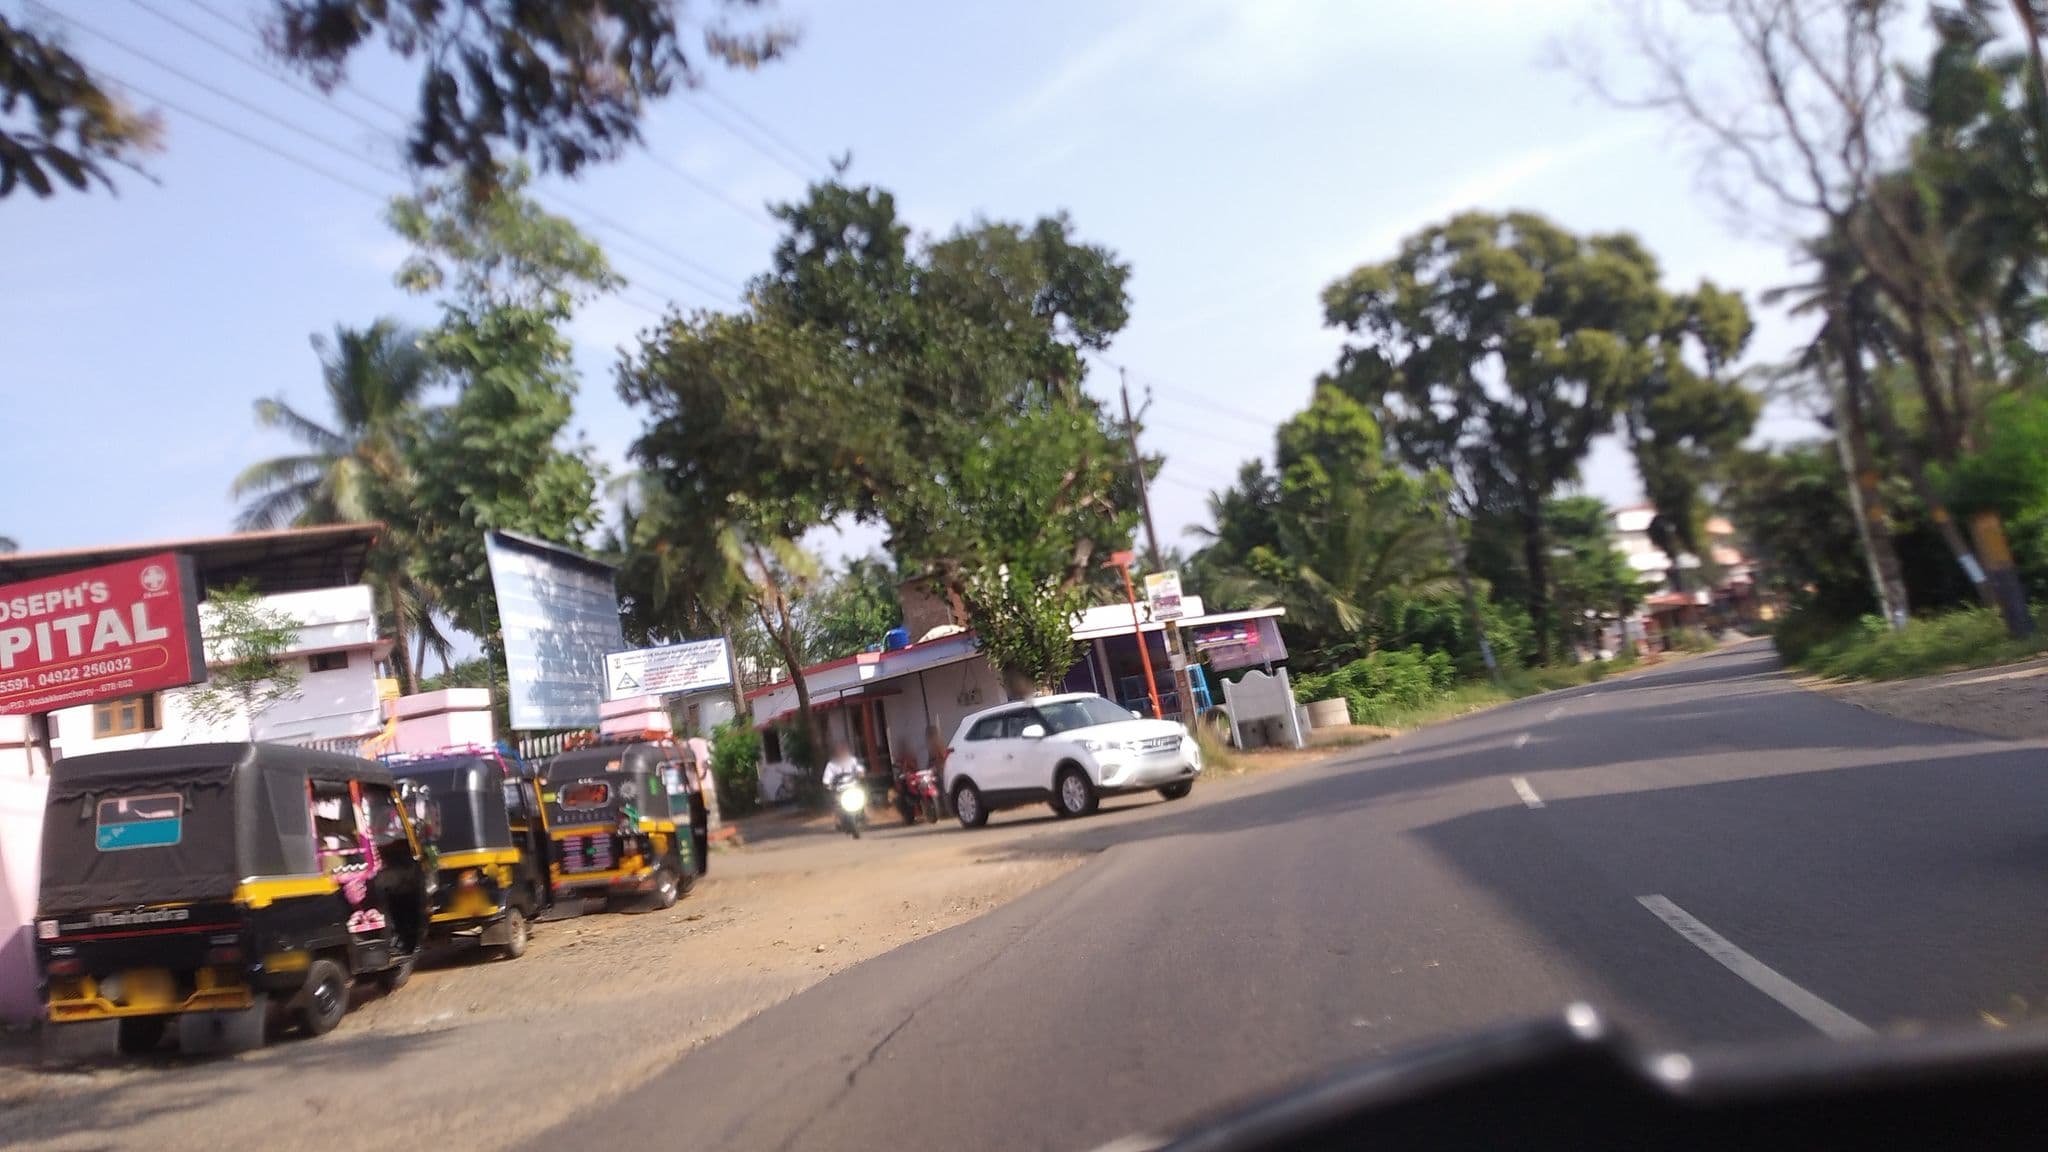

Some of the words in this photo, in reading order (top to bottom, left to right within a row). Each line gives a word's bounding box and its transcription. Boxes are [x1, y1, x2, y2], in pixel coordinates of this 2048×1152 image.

[0, 602, 168, 669] PITAL
[38, 667, 80, 686] 04922
[82, 657, 132, 677] 256032
[91, 907, 189, 927] Mahindra
